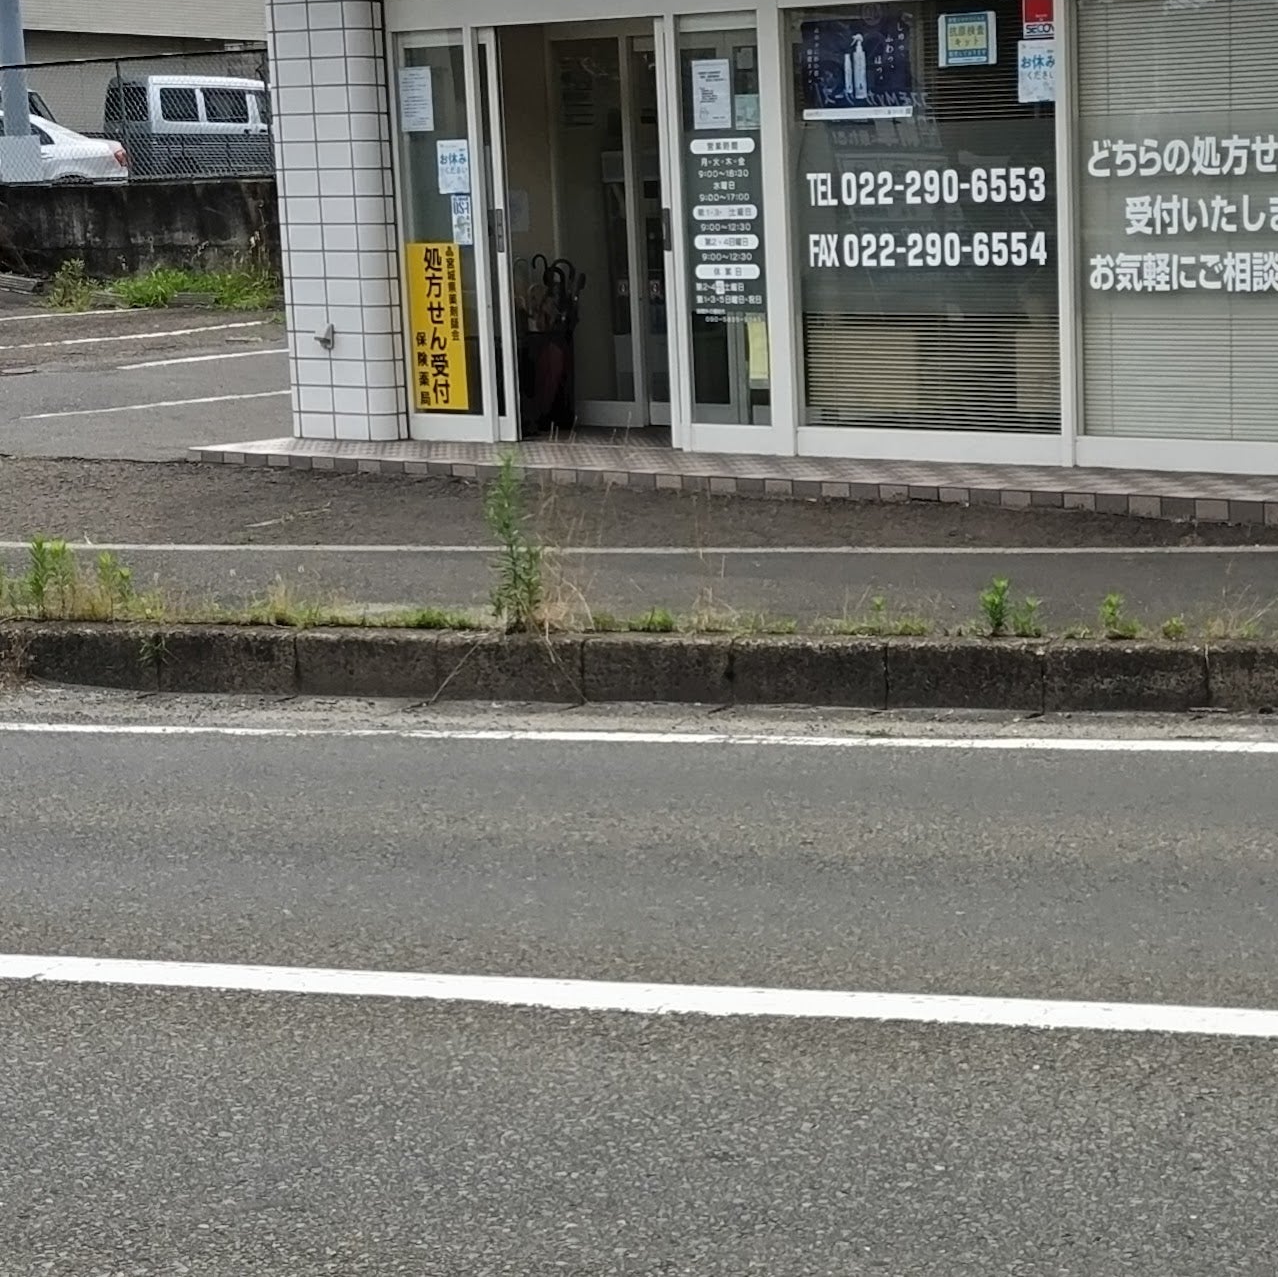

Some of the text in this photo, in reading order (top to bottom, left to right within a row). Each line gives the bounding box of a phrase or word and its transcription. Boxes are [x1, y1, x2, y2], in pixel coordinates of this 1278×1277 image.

[1021, 54, 1056, 69] お休み
[440, 152, 467, 166] お休み
[806, 166, 1047, 208] TEL 022-290-6553
[809, 230, 1047, 268] FAX 022-290-6554
[423, 246, 450, 405] 処方せん受付
[416, 332, 432, 406] 保険薬局
